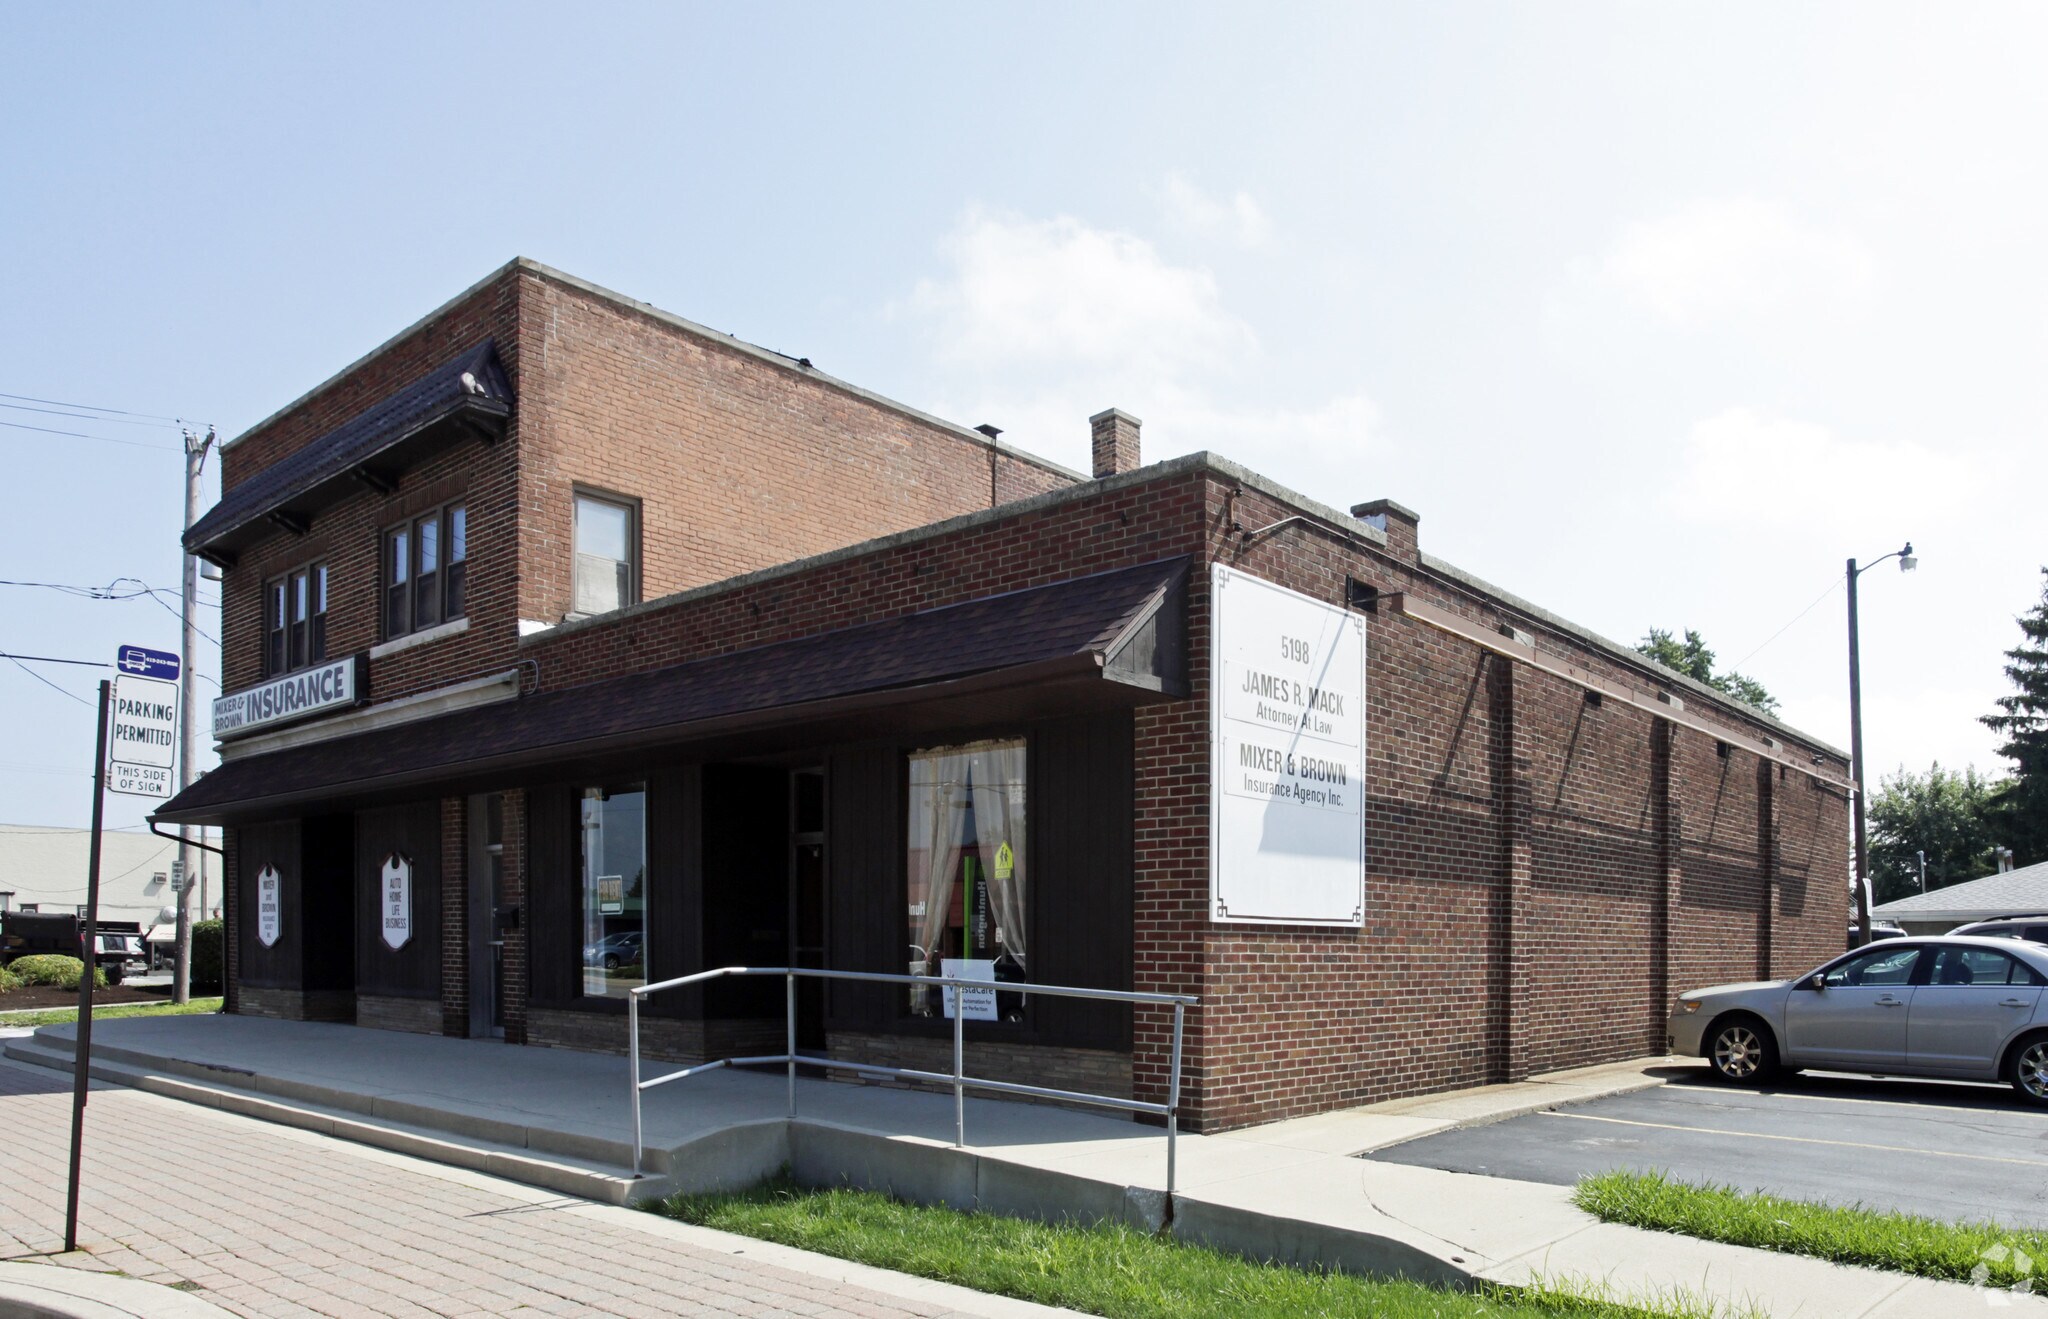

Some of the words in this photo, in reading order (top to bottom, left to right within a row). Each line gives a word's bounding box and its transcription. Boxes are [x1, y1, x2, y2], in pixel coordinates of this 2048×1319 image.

[1281, 635, 1309, 664] 5198
[246, 665, 344, 722] INSURANCE
[1242, 669, 1289, 703] JAMES
[1293, 681, 1305, 707] R.
[1308, 686, 1344, 717] MACK
[118, 698, 173, 721] PARKING
[214, 698, 237, 716] MIXER
[214, 712, 243, 731] BROWN
[1256, 701, 1298, 731] Attorney
[1300, 712, 1312, 730] At
[1314, 715, 1333, 734] Law
[116, 724, 172, 746] PERMITTED
[117, 766, 140, 777] THIS
[143, 769, 166, 781] SIDE
[1239, 743, 1282, 774] MIXER
[1287, 753, 1296, 776] &
[1301, 755, 1347, 786] BROWN
[120, 779, 134, 789] OF
[138, 781, 162, 792] SIGN
[1244, 772, 1290, 798] Insurance
[1293, 782, 1326, 807] Agency
[1328, 788, 1344, 806] Inc.
[389, 878, 402, 889] AUTO
[389, 891, 402, 903] HOME
[391, 904, 401, 916] LIFE
[385, 917, 407, 929] BUSINESS
